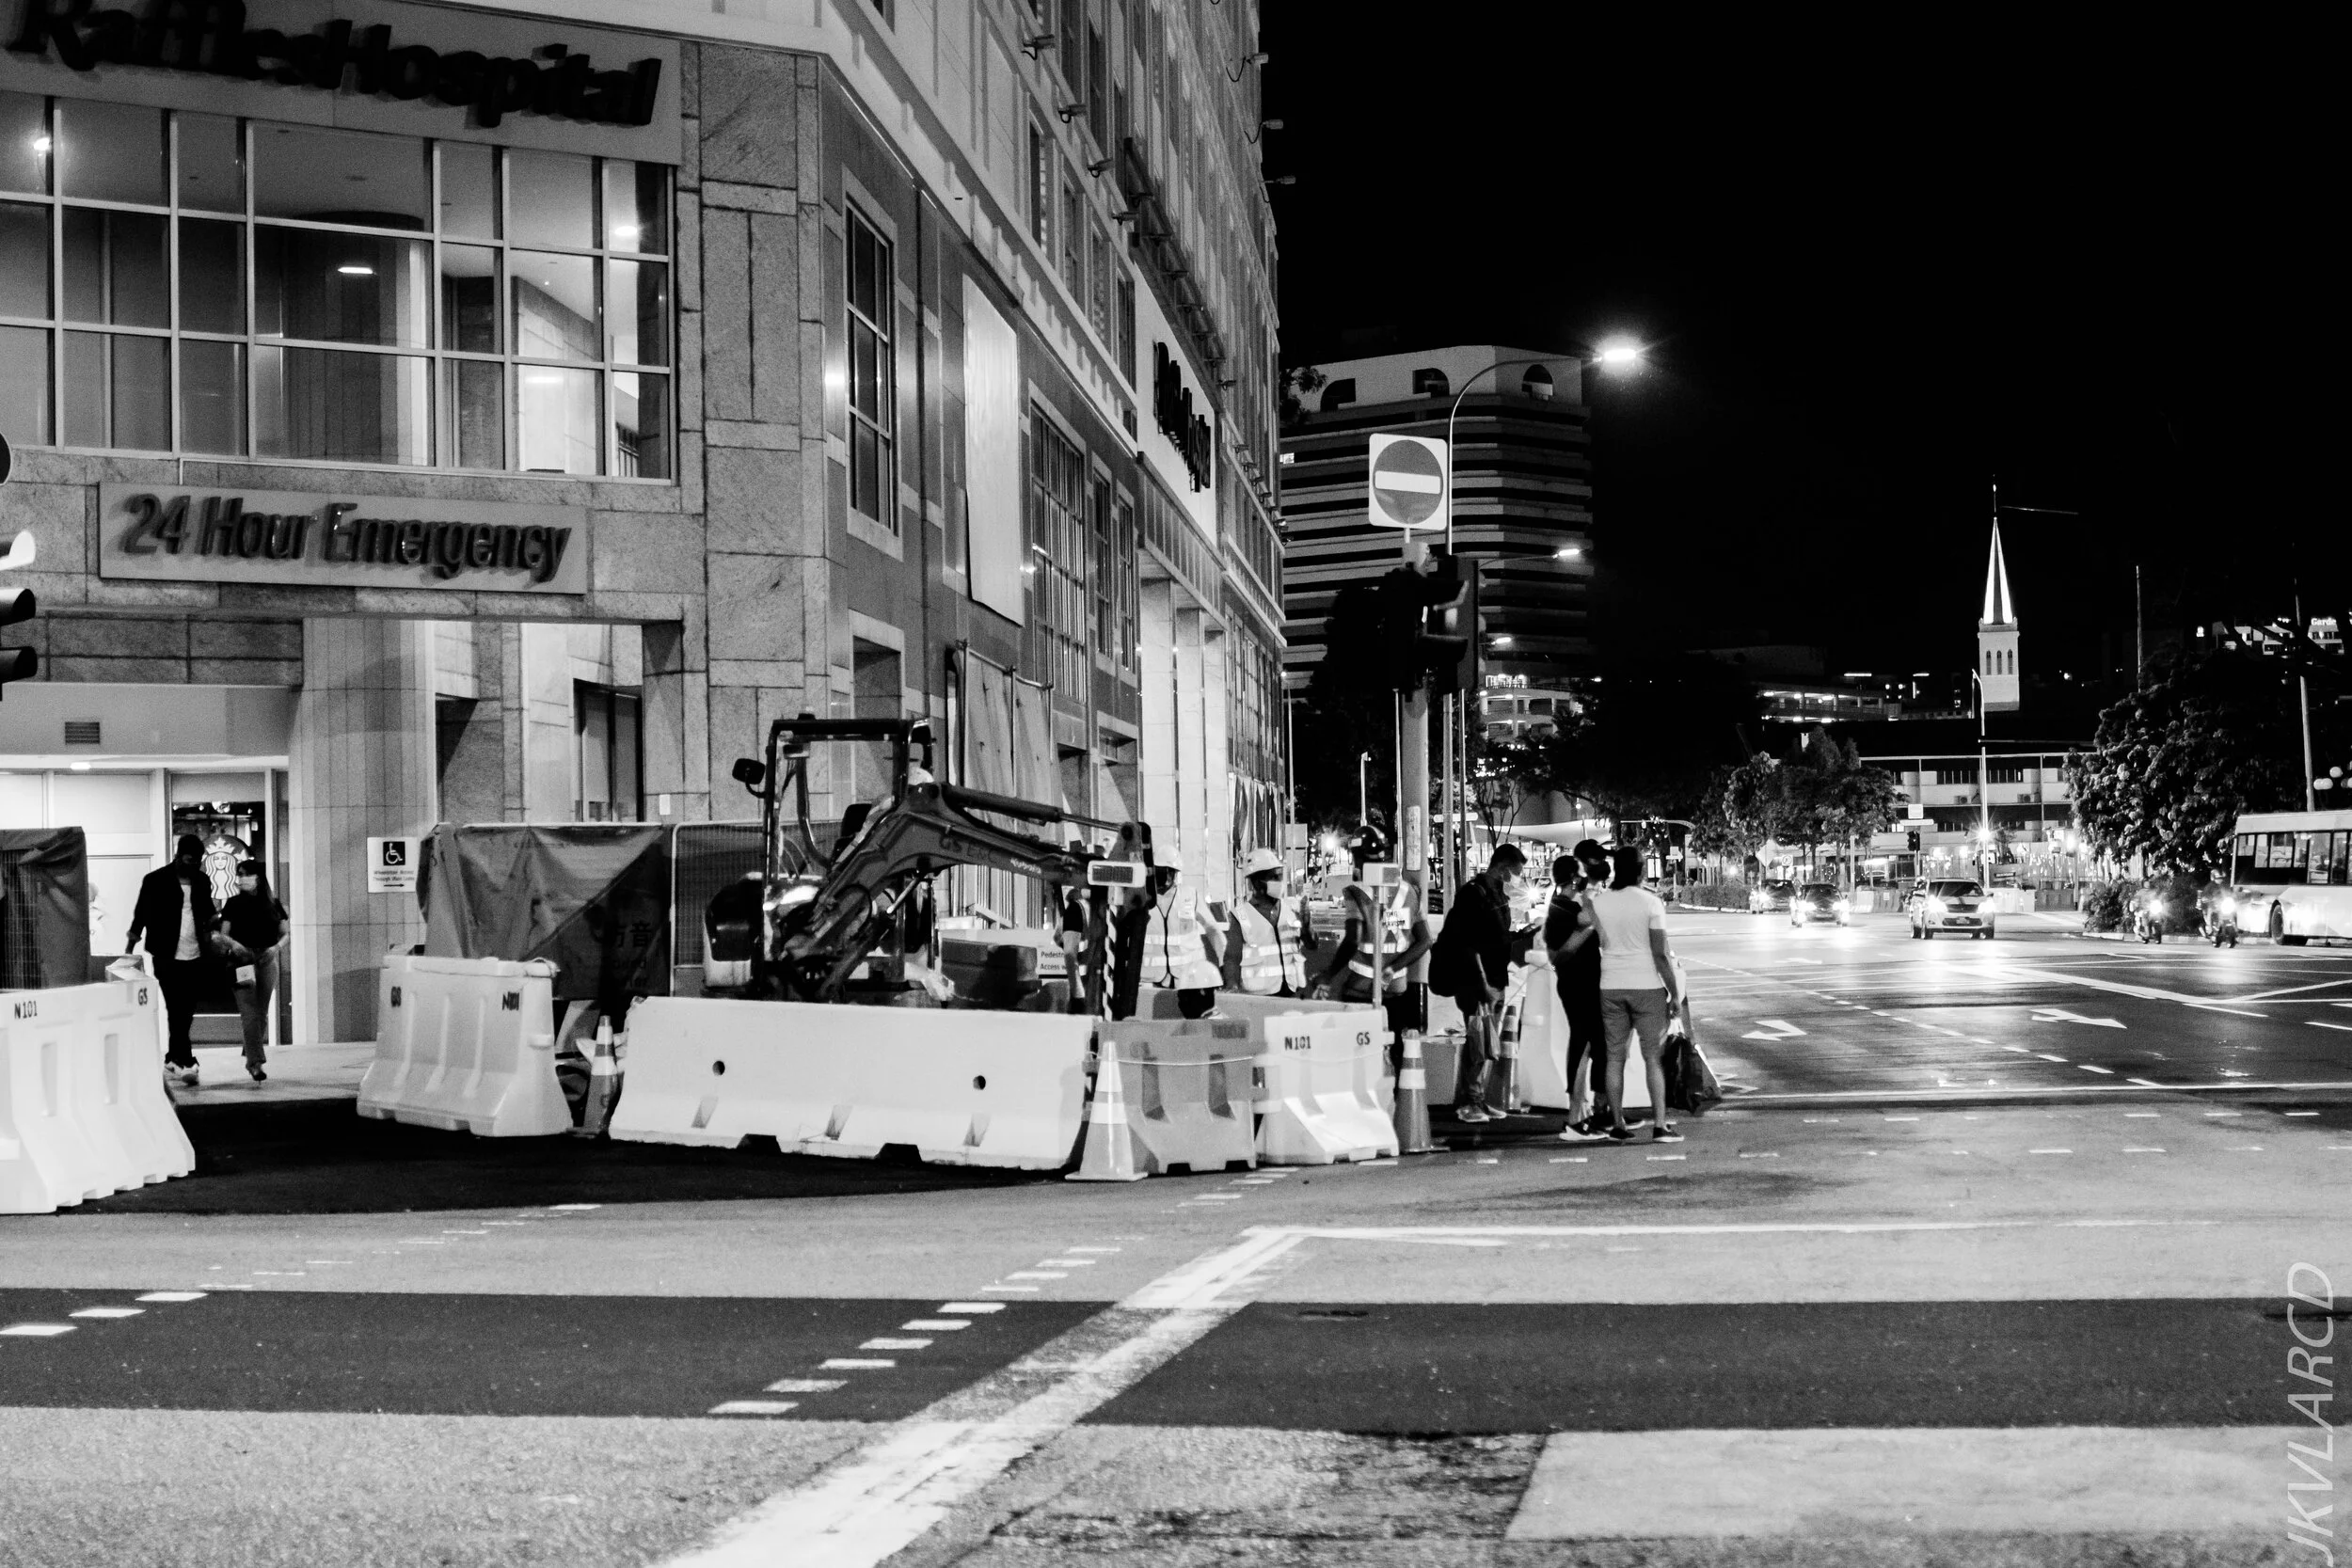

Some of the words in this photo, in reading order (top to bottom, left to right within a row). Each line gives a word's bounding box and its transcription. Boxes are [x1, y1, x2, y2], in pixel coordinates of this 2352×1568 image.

[121, 493, 191, 555] 24
[199, 497, 318, 562] Hour
[325, 502, 572, 585] Emergency
[137, 988, 149, 1006] GS
[14, 1001, 38, 1019] N101
[1284, 1036, 1311, 1051] N101
[1356, 1032, 1371, 1046] GS
